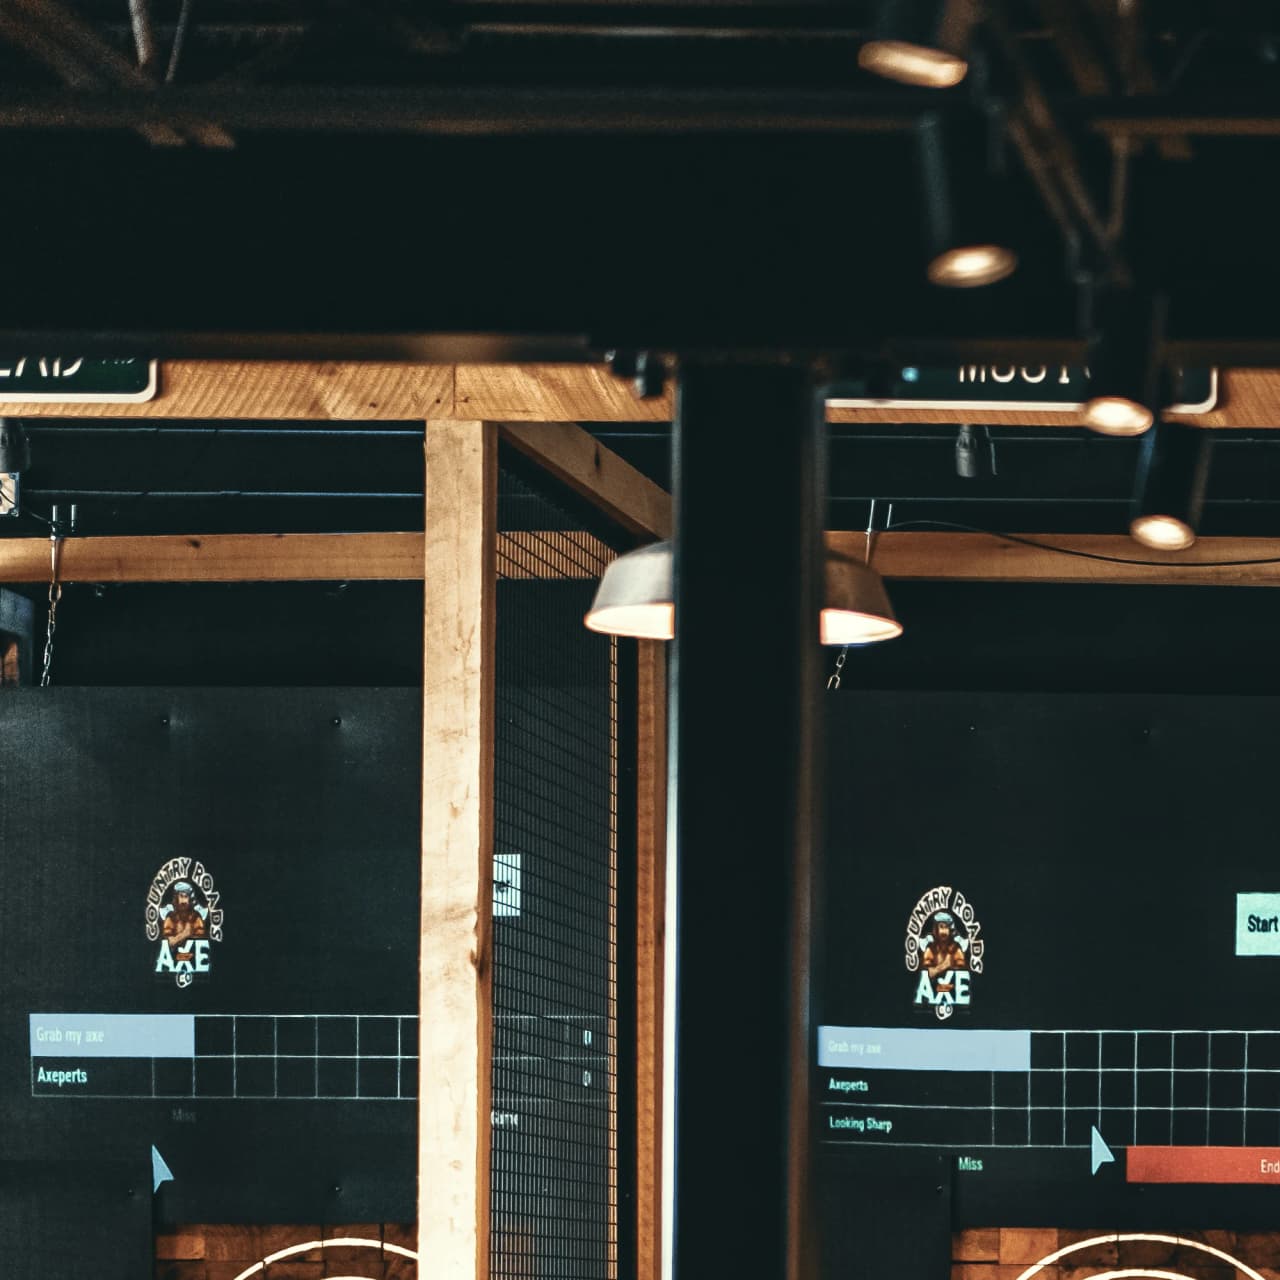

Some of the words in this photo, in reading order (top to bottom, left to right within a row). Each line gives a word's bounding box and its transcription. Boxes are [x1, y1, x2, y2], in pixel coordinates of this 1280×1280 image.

[146, 857, 191, 941] COUNTRY
[192, 862, 223, 941] ROADS
[905, 886, 952, 971] COUNTRY
[952, 891, 984, 974] ROADS
[1248, 914, 1279, 933] Start
[155, 939, 210, 972] AXE
[914, 970, 971, 1005] AXE
[36, 1027, 62, 1042] Grab
[65, 1030, 82, 1044] my
[85, 1030, 105, 1042] axe
[37, 1066, 88, 1087] Axeperts
[829, 1078, 869, 1093] Axeperts
[829, 1116, 865, 1132] Looking
[867, 1117, 893, 1133] Sharp
[958, 1156, 983, 1171] Miss
[1260, 1159, 1280, 1174] End
